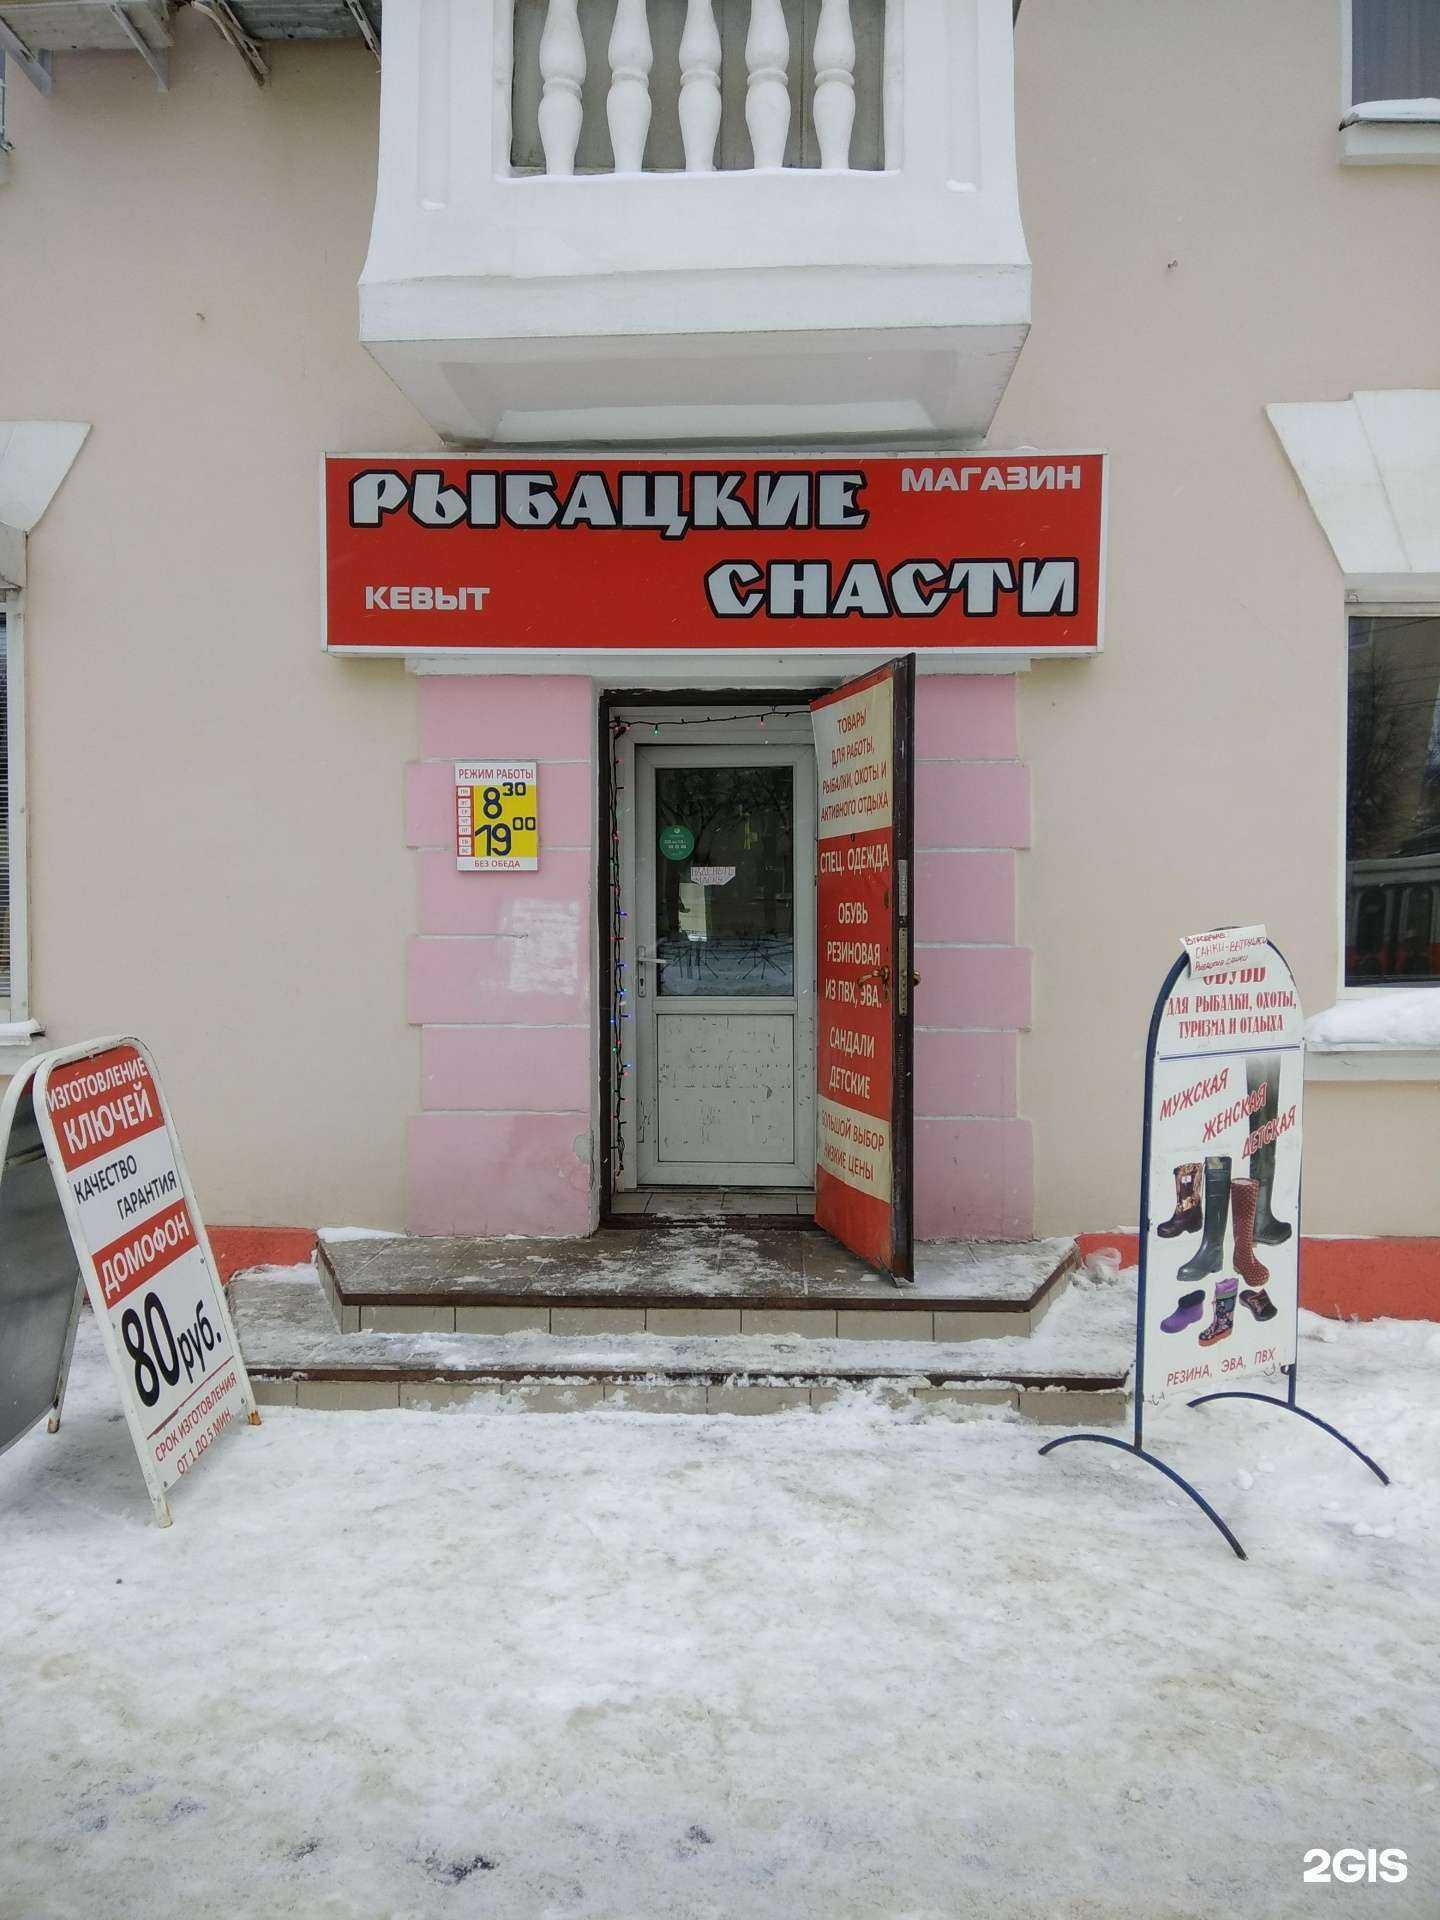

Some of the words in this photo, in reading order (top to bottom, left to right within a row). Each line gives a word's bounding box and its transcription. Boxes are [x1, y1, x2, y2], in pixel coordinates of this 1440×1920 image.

[901, 465, 1082, 493] МАГАЗИН
[350, 470, 871, 540] РЫБАЦКИЕ
[365, 585, 490, 612] КЕВЫТ
[705, 558, 1080, 619] СНАСТИ
[837, 704, 867, 735] ТОВАРЫ
[459, 769, 493, 779] РЕЖИМ
[496, 768, 534, 779] РАБОТЫ
[831, 747, 845, 768] ДЛЯ
[854, 764, 879, 786] ОХОТЫ
[881, 760, 887, 778] И
[821, 799, 856, 822] АКТИВНОГО
[857, 791, 888, 816] ОТДЫХА
[491, 860, 521, 868] ОБЕДА
[820, 850, 845, 876] СПЕЦ.
[847, 843, 889, 876] ОДЕЖДА
[838, 901, 869, 925] ОБУВЬ
[827, 941, 880, 966] РЕЗИНОВАЯ
[825, 978, 836, 1000] ИЗ
[838, 980, 858, 1008] ПВХ,
[1167, 997, 1189, 1016] ДЛЯ
[1195, 993, 1253, 1013] РЫБАЛКИ,
[1256, 991, 1297, 1009] ОХОТЫ,
[829, 1026, 875, 1059] САНДАЛИ
[1179, 1019, 1226, 1039] ТУРИЗМА
[1229, 1018, 1236, 1034] И
[1240, 1014, 1283, 1034] ОТДЫХА
[46, 1056, 148, 1112] ИЗГОТОВЛЕНИЕ
[829, 1065, 871, 1099] ДЕТСКИЕ
[1160, 1067, 1230, 1121] МУЖСКАЯ
[62, 1081, 153, 1154] КЛЮЧЕЙ
[1202, 1080, 1268, 1144] ЖЕНСКАЯ
[853, 1125, 884, 1152] ВЫБОР
[1242, 1105, 1297, 1160] ДЕТСКАЯ
[73, 1155, 138, 1204] КАЧЕСТВО
[848, 1154, 874, 1181] ЦЕНЫ
[116, 1170, 177, 1221] ГАРАНТИЯ
[102, 1211, 190, 1300] ДОМОФОН
[1166, 1365, 1213, 1387] РЕЗИНА,
[1221, 1356, 1247, 1373] ЭВА,
[1254, 1347, 1276, 1365] ПВХ
[155, 1430, 180, 1462] СРОК
[177, 1371, 237, 1440] ИЗГОТОВЛЕНИЯ
[177, 1453, 190, 1475] ОТ
[188, 1448, 197, 1462] 1
[195, 1434, 208, 1456] ДО
[207, 1428, 214, 1443] 5
[212, 1408, 234, 1437] МИН.
